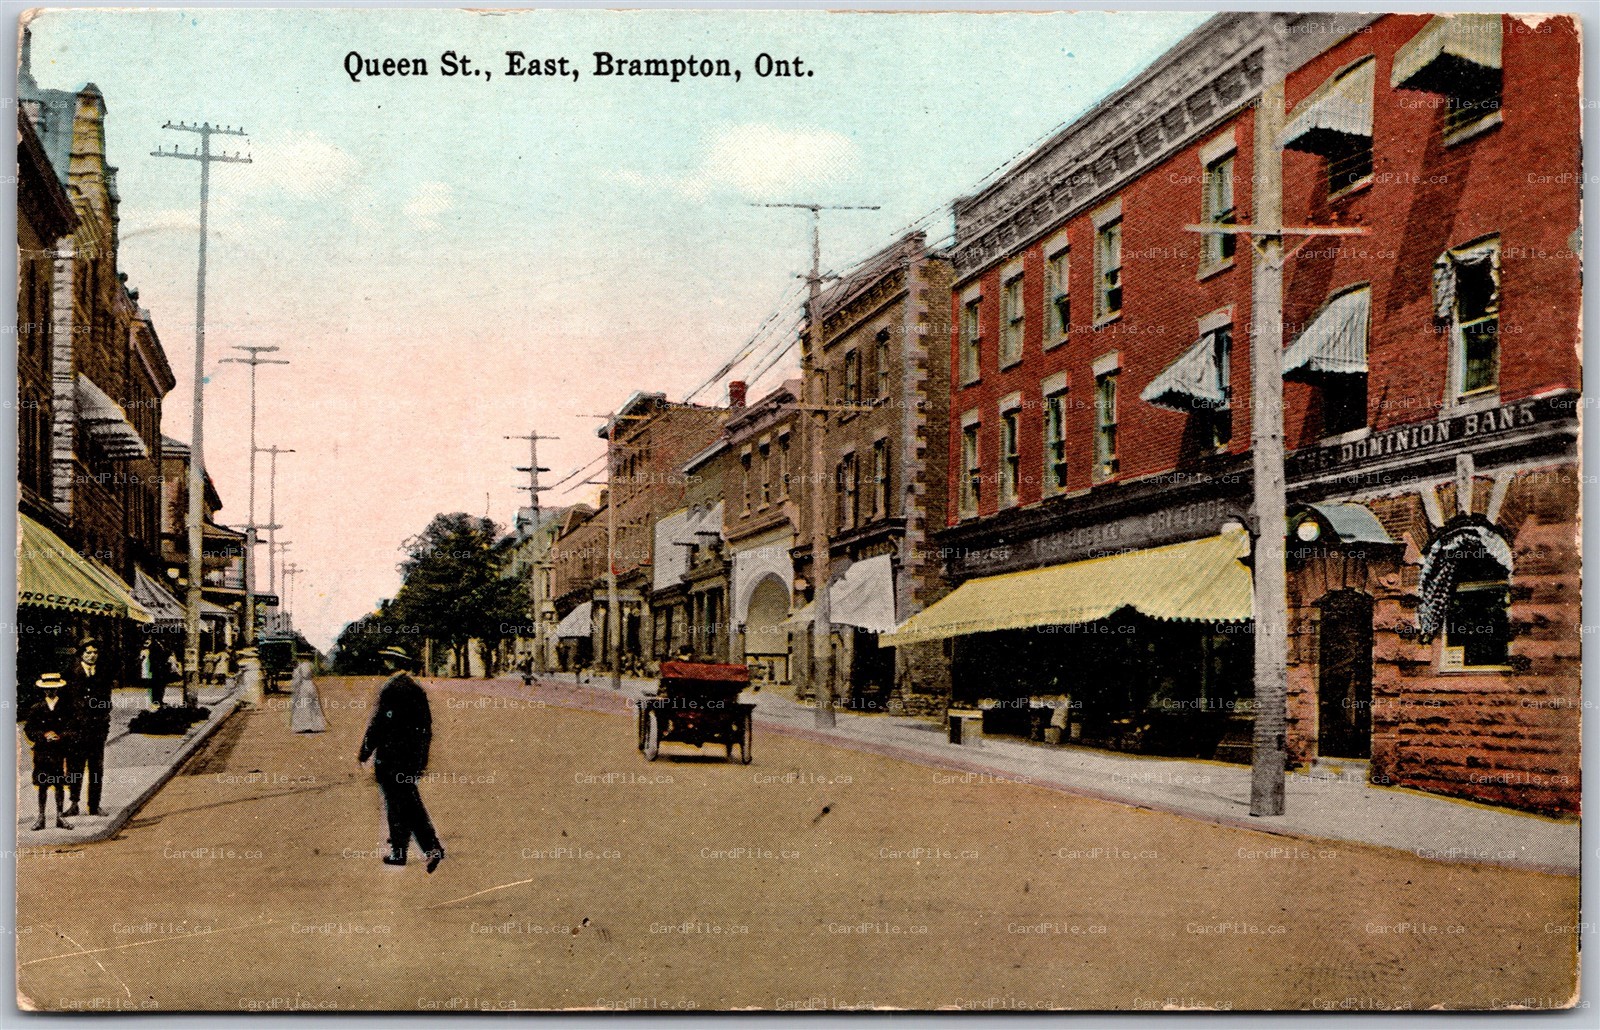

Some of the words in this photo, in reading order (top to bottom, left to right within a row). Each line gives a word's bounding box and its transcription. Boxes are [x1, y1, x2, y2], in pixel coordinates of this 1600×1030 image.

[1341, 420, 1451, 464] DOMINION
[1464, 402, 1536, 435] BANK
[19, 591, 114, 612] ROCERIES
